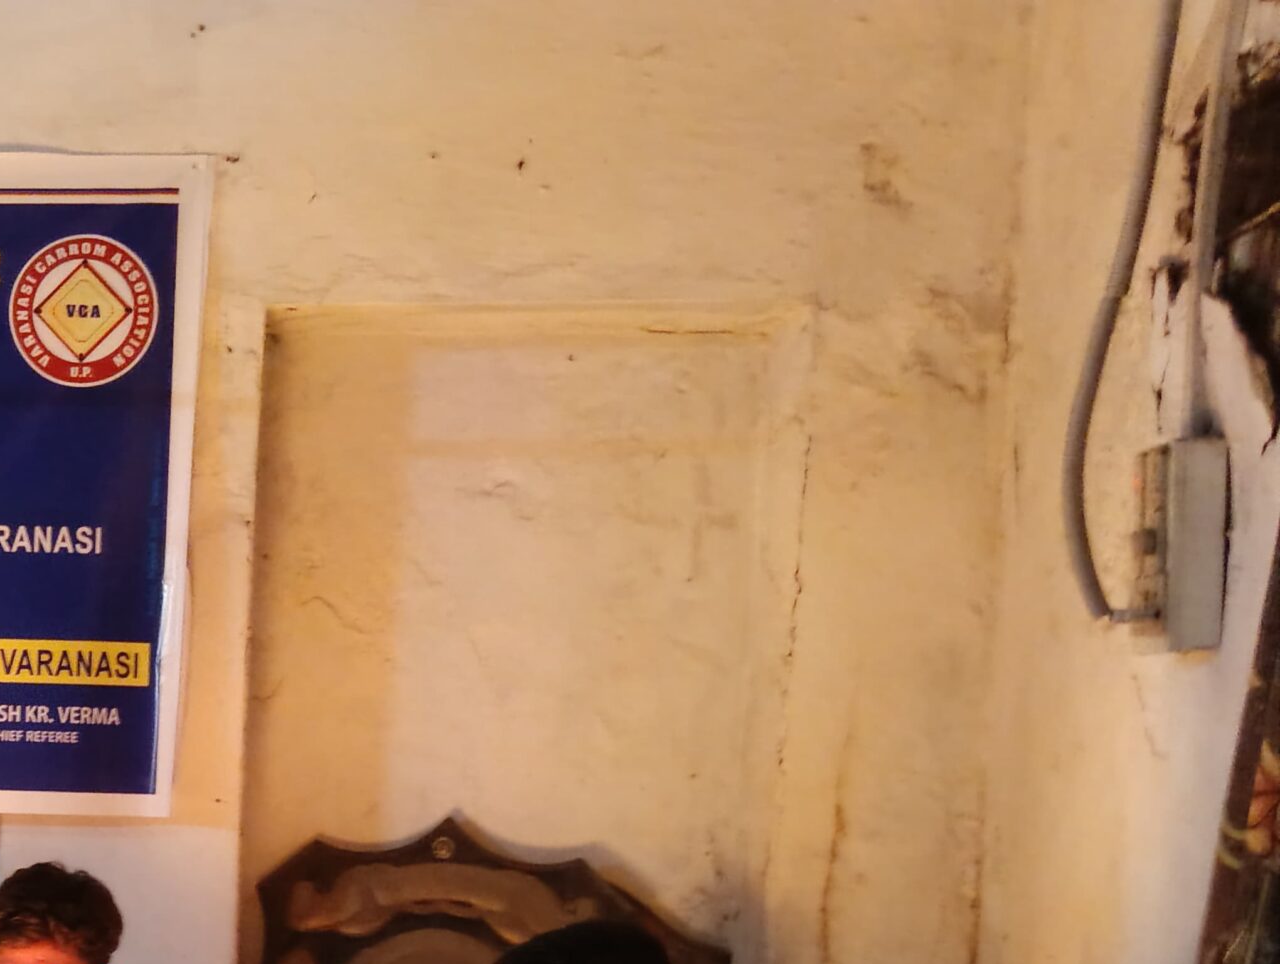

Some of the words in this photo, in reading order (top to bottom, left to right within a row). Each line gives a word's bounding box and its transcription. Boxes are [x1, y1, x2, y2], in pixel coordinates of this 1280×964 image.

[16, 275, 51, 368] VARANASI
[35, 242, 107, 273] CARROM
[110, 253, 150, 367] ASSOCIATION
[70, 367, 93, 378] U.P.
[1, 649, 138, 678] VARANASI
[58, 707, 120, 725] VERMA
[26, 731, 78, 743] REFEREE
